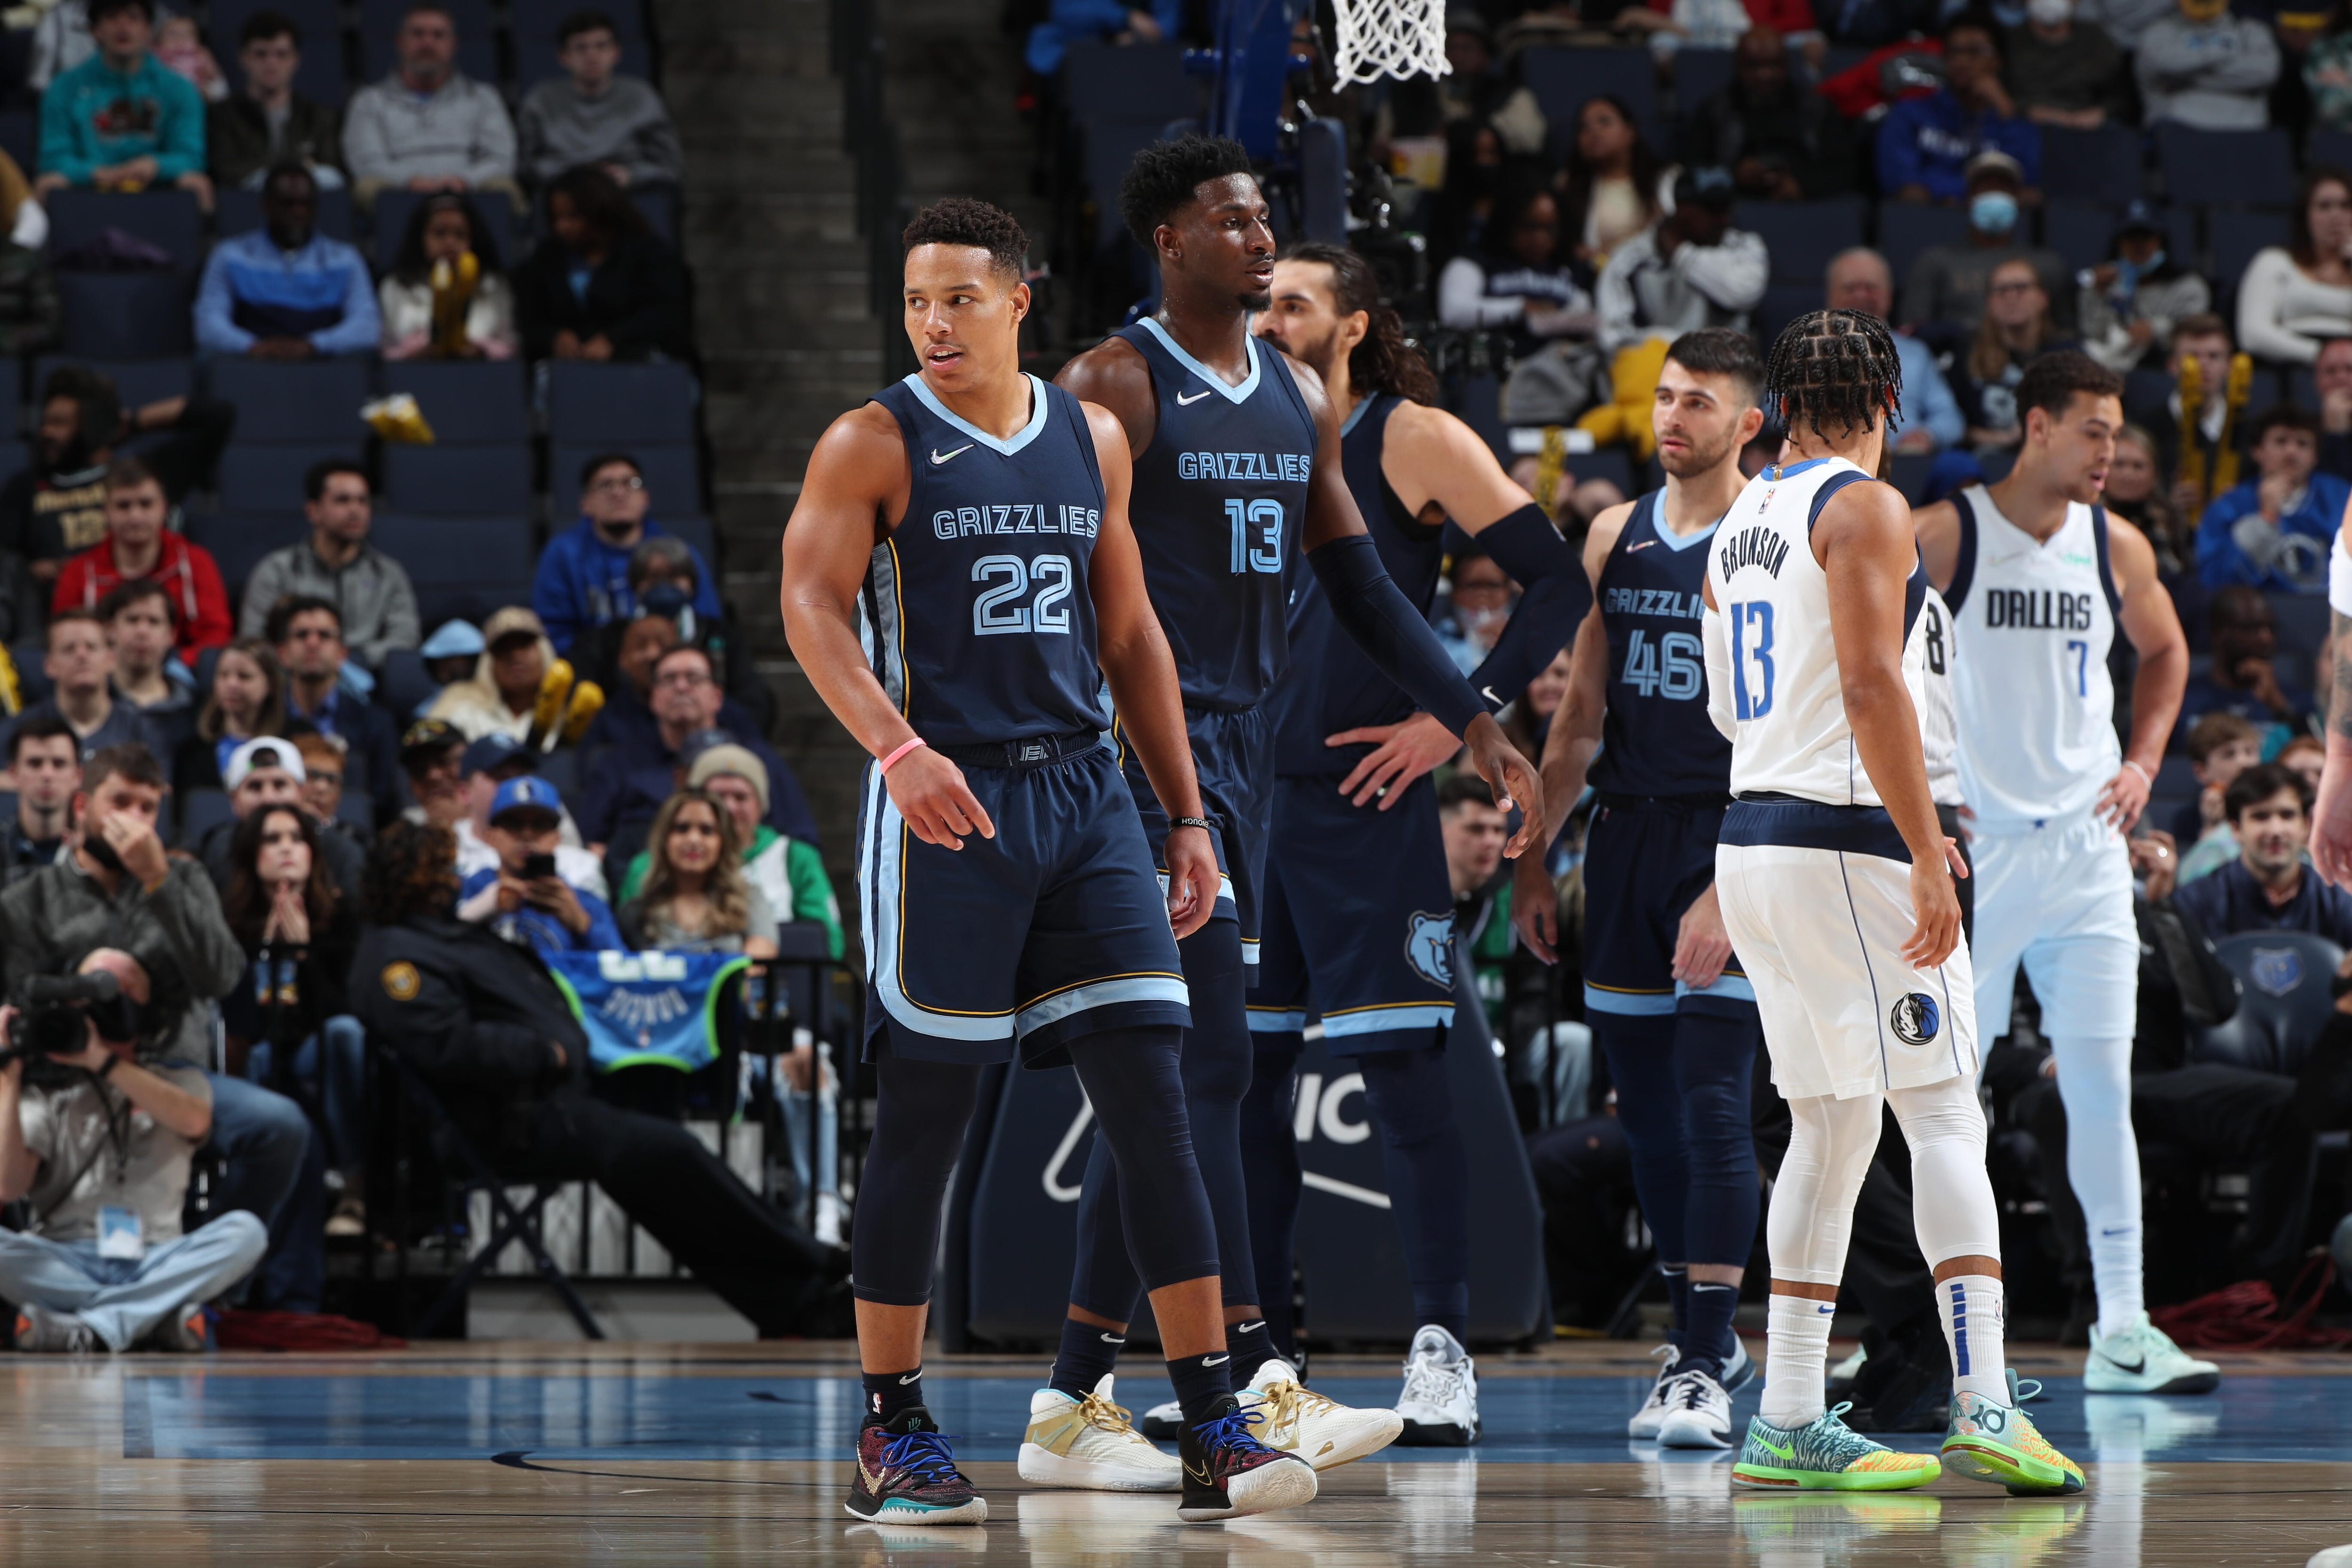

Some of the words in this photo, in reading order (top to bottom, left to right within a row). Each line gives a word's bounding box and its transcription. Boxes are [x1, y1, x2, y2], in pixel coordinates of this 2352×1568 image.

[1177, 452, 1310, 483] GRIZZLIES
[933, 504, 1099, 540] GRIZZLIES
[1225, 499, 1284, 573] 13
[1721, 526, 1790, 585] BRUNSON
[971, 554, 1072, 636] 22
[1605, 588, 1705, 620] GRIZZLI
[1986, 589, 2090, 630] DALLAS
[1621, 629, 1703, 700] 46
[1731, 600, 1775, 723] 13
[1922, 602, 1946, 676] 8
[2067, 640, 2088, 697] 7
[1182, 818, 1209, 829] ENOUGH
